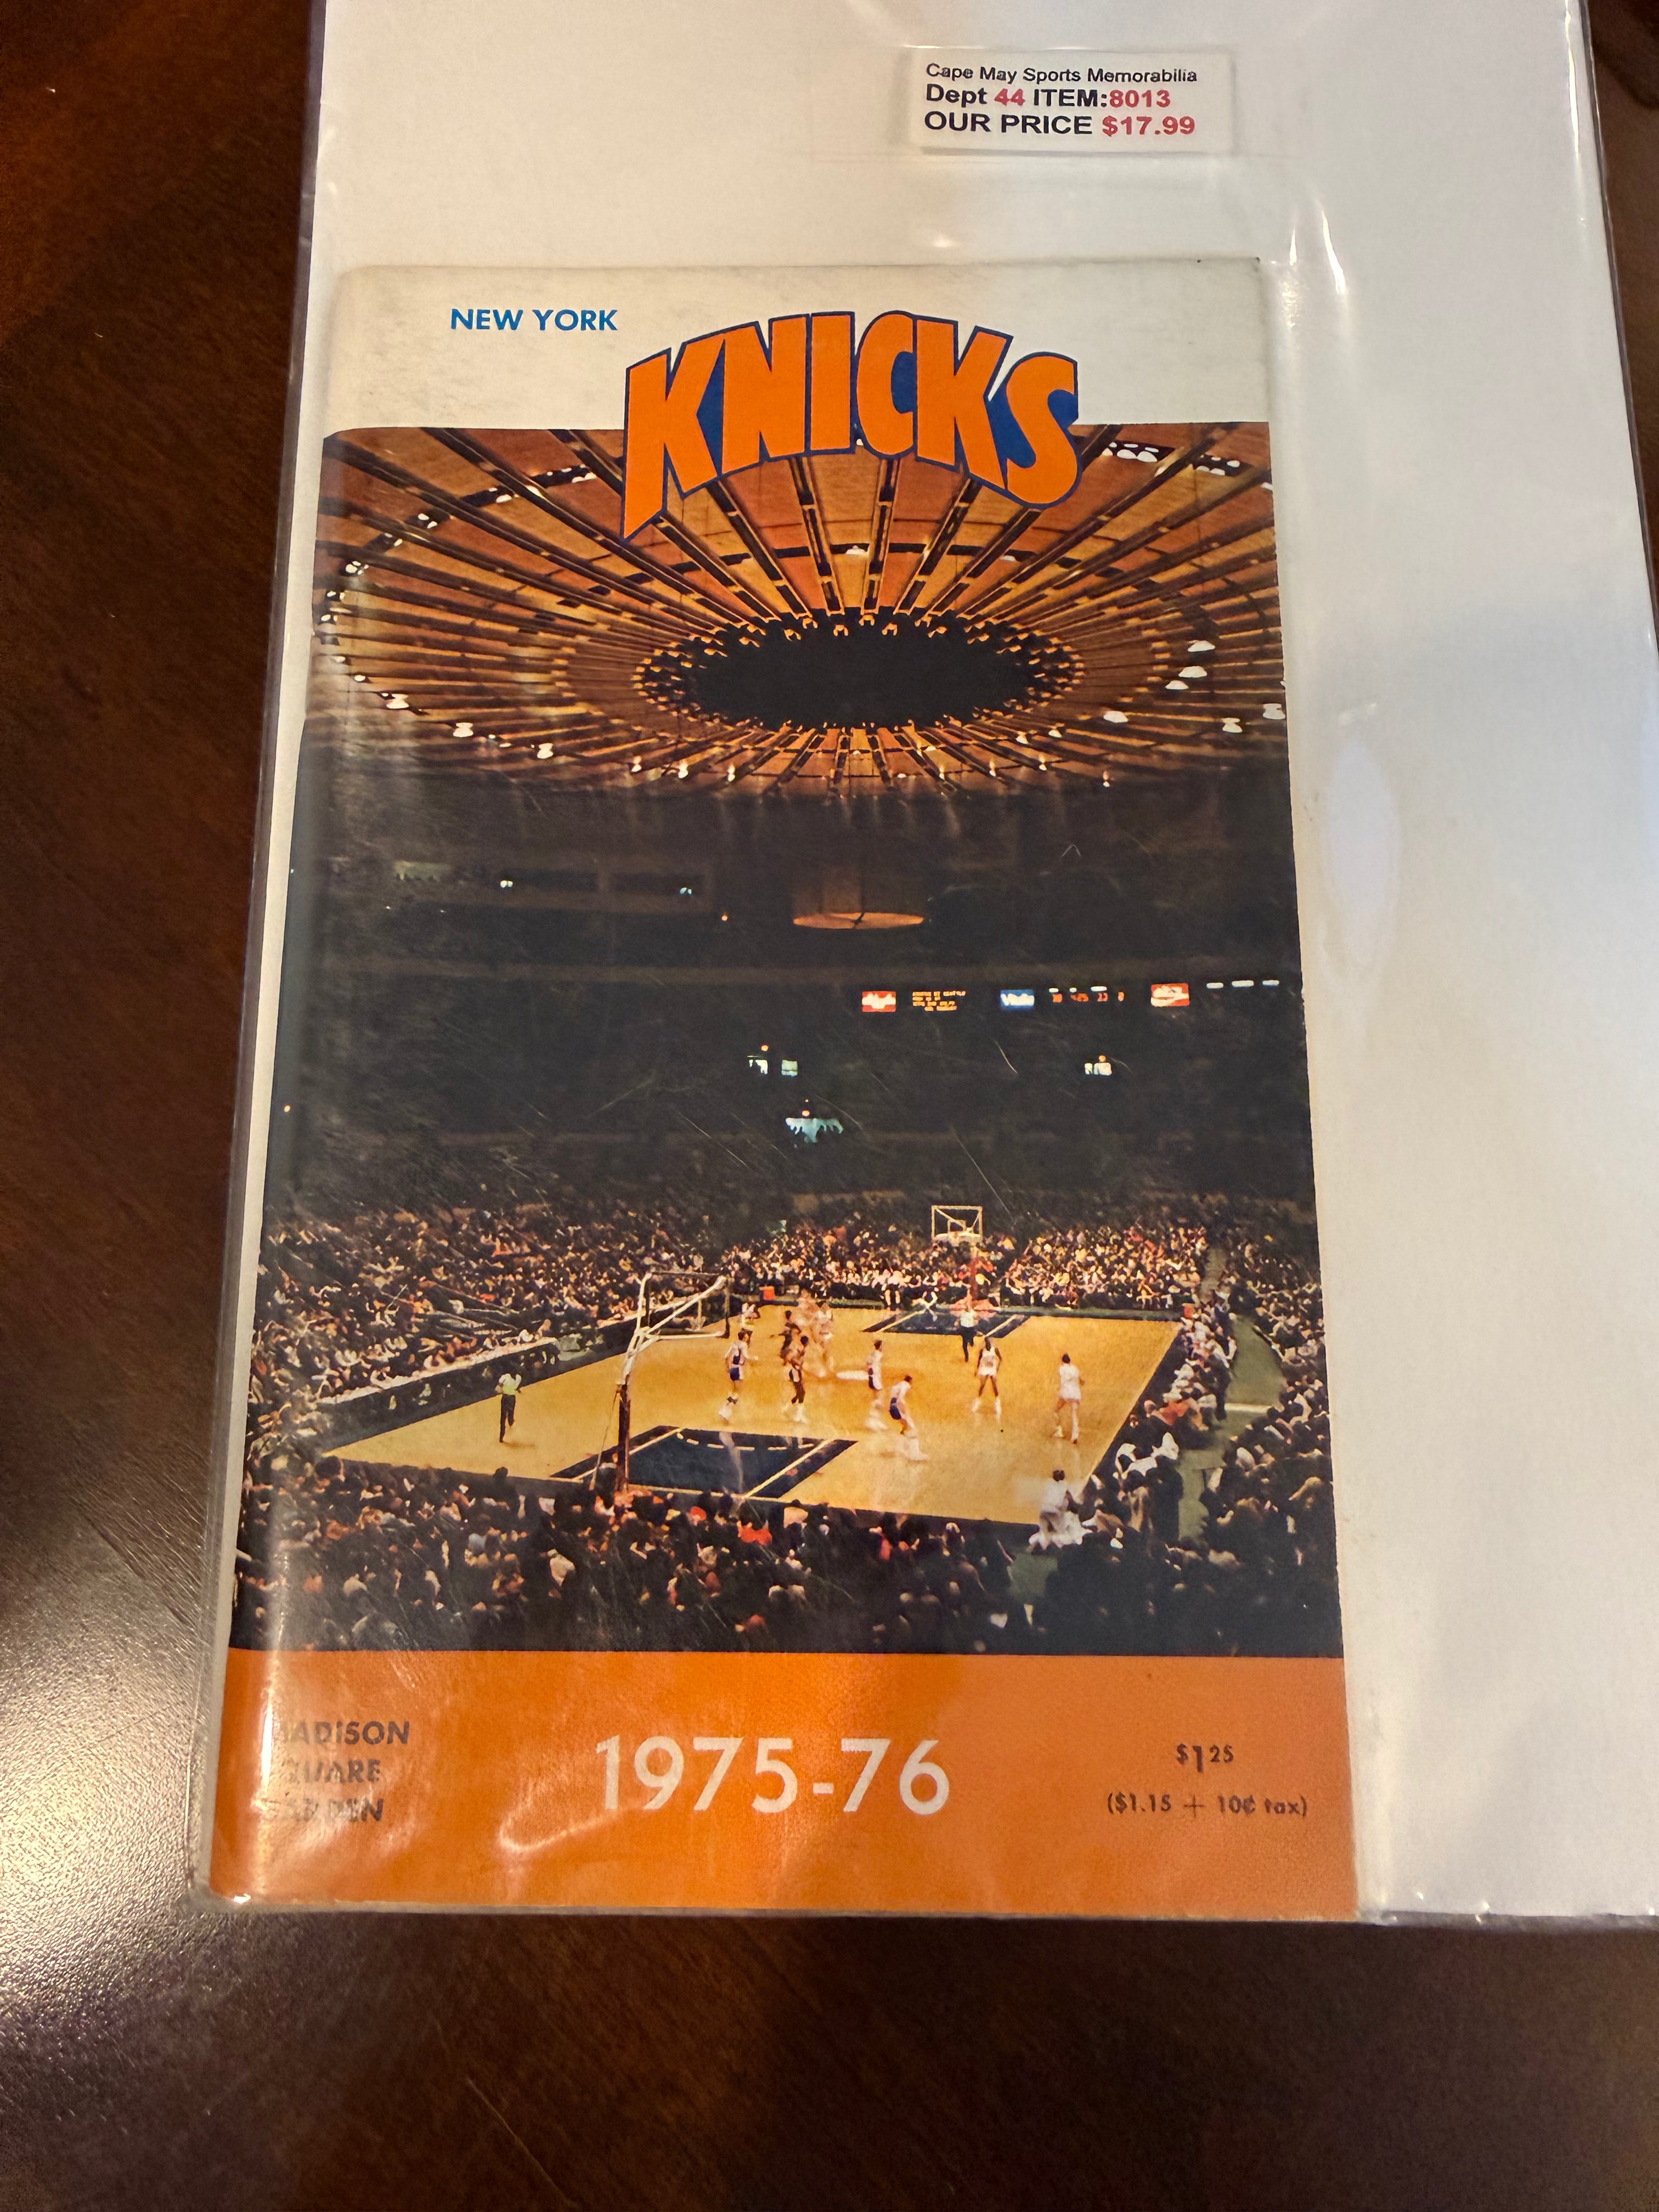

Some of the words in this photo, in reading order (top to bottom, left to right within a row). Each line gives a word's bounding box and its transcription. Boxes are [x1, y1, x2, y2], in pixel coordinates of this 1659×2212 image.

[926, 63, 974, 80] Cape
[979, 66, 1018, 84] May
[1022, 67, 1082, 83] Sports
[1087, 68, 1198, 82] Memorabilia
[926, 83, 988, 106] Dept
[994, 88, 1026, 105] 44
[924, 111, 991, 133] OUR
[1000, 114, 1093, 134] PRICE
[1102, 115, 1195, 137] $17.99
[450, 308, 523, 331] NEW
[532, 309, 618, 331] YORK
[620, 310, 1082, 543] KNICKS
[271, 1720, 410, 1745] ADISON
[596, 1735, 950, 1815] 1975-76
[1107, 1791, 1172, 1815] ($1.15
[1263, 1794, 1307, 1817] tax)
